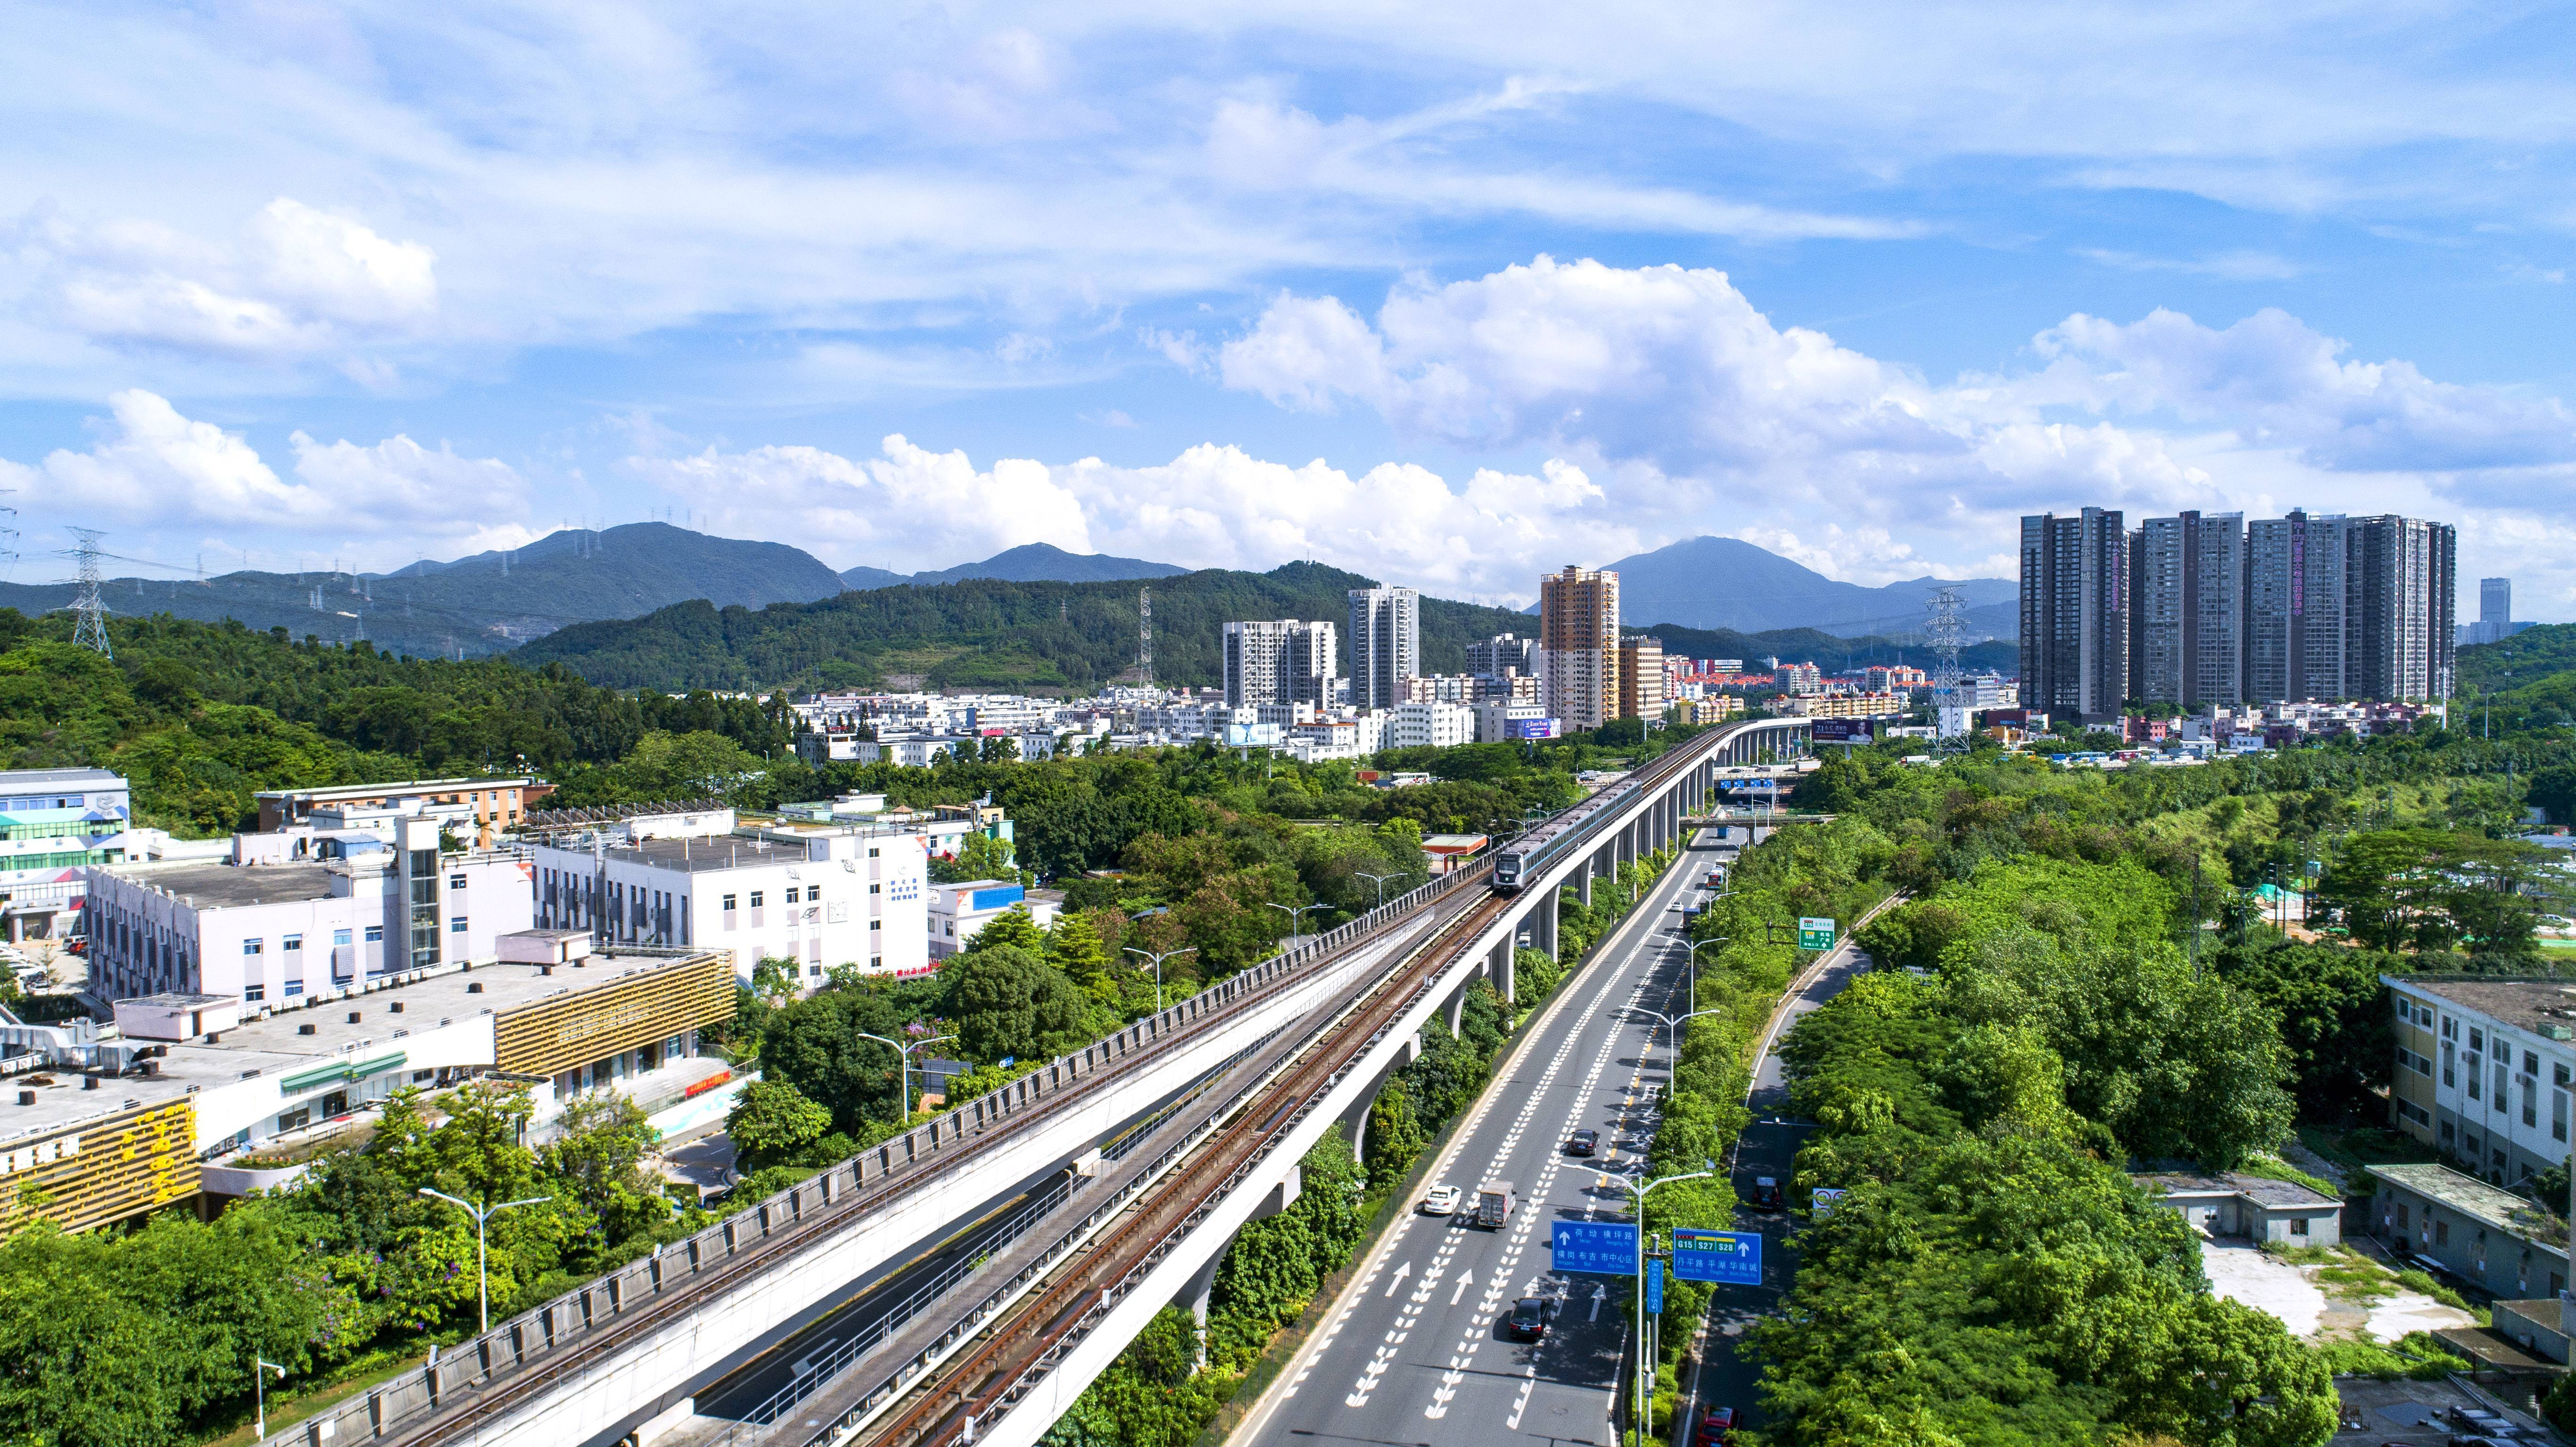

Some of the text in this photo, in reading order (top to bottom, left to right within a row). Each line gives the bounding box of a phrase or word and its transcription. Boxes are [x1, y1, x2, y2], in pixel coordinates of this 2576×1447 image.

[1575, 1228, 1633, 1240] 荷坳 横坪路
[1678, 1241, 1734, 1251] G15 S27 S28
[1557, 1250, 1633, 1264] 横岗 布吉 市中心区
[1677, 1257, 1758, 1272] 丹平路 平湖 华南城
